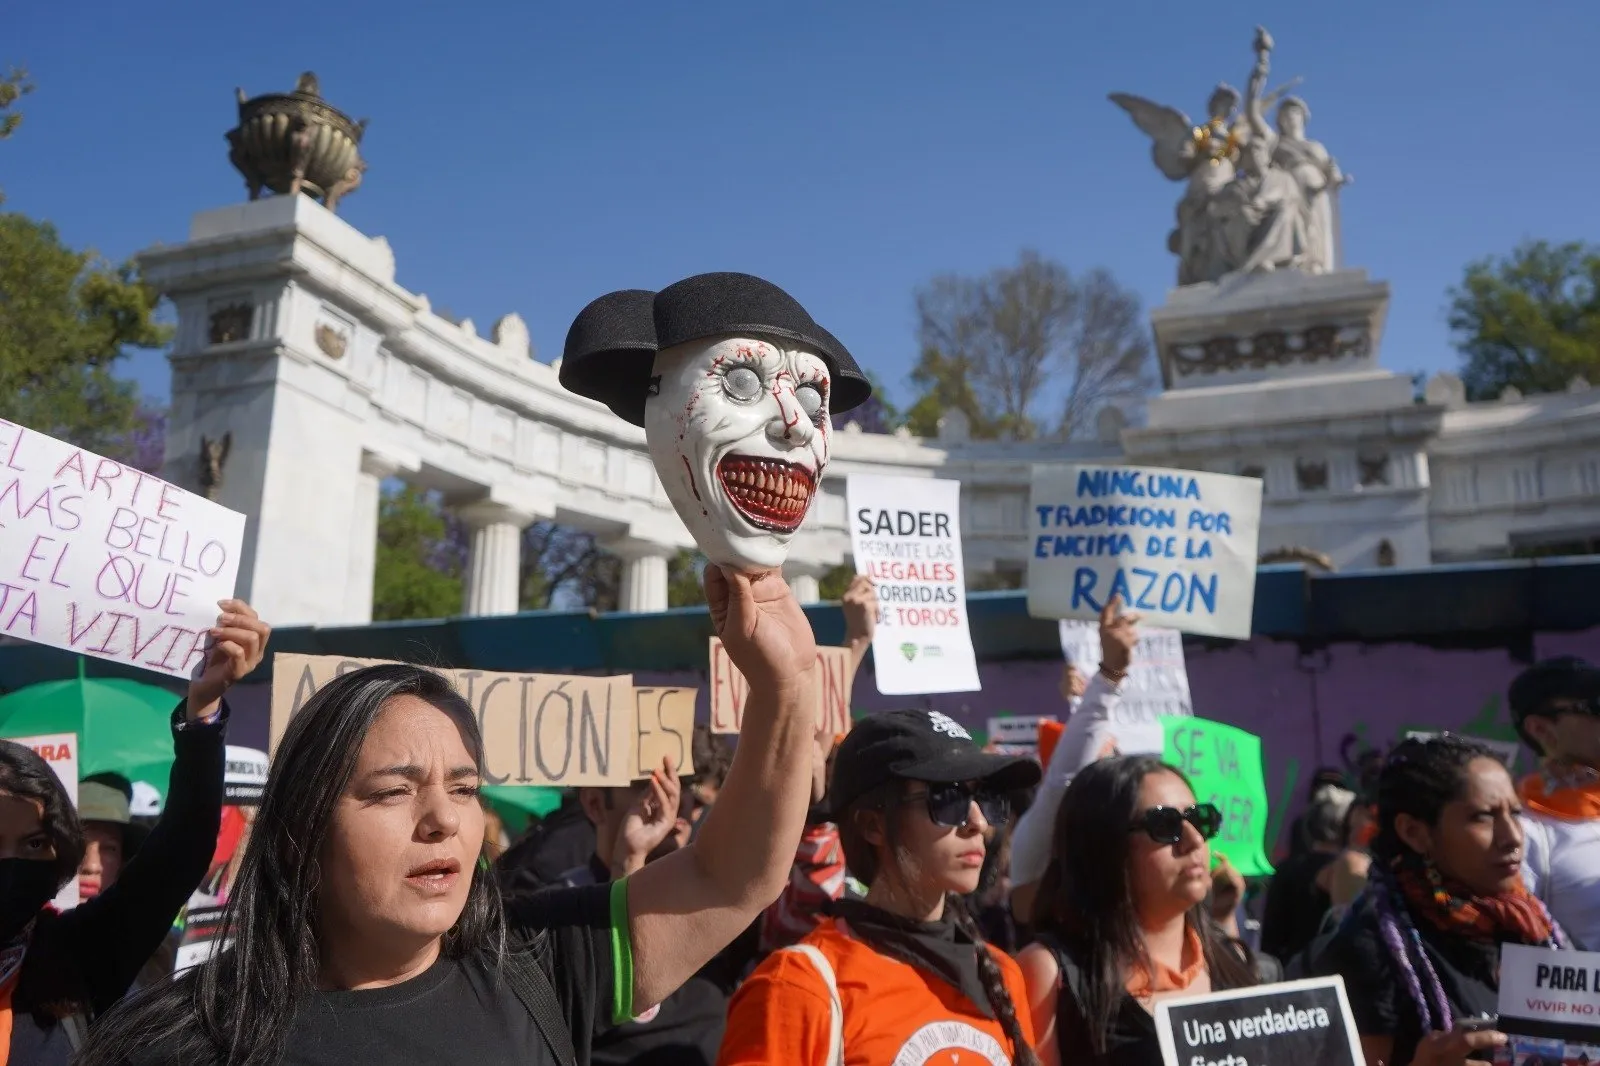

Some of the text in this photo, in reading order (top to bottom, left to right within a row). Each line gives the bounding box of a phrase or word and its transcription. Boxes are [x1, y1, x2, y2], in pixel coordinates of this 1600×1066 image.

[54, 450, 185, 521] ARTE
[1077, 469, 1201, 500] NINGUNA
[858, 508, 951, 538] SADER
[1036, 504, 1232, 535] TRADICION POR
[105, 507, 226, 577] BELLO
[860, 539, 954, 560] PERMITE LAS
[1035, 533, 1213, 559] ENCIMA DE LA
[21, 534, 194, 615] EL QUE
[872, 584, 957, 603] ORRIDAS
[1072, 567, 1219, 614] RAZON
[897, 608, 959, 627] TOROS
[637, 689, 684, 775] ES
[33, 744, 71, 761] RA
[1172, 727, 1241, 780] SE VA
[1536, 963, 1588, 992] PARA
[1526, 999, 1594, 1015] VIVIR NO
[1183, 1004, 1330, 1047] Una verdadera
